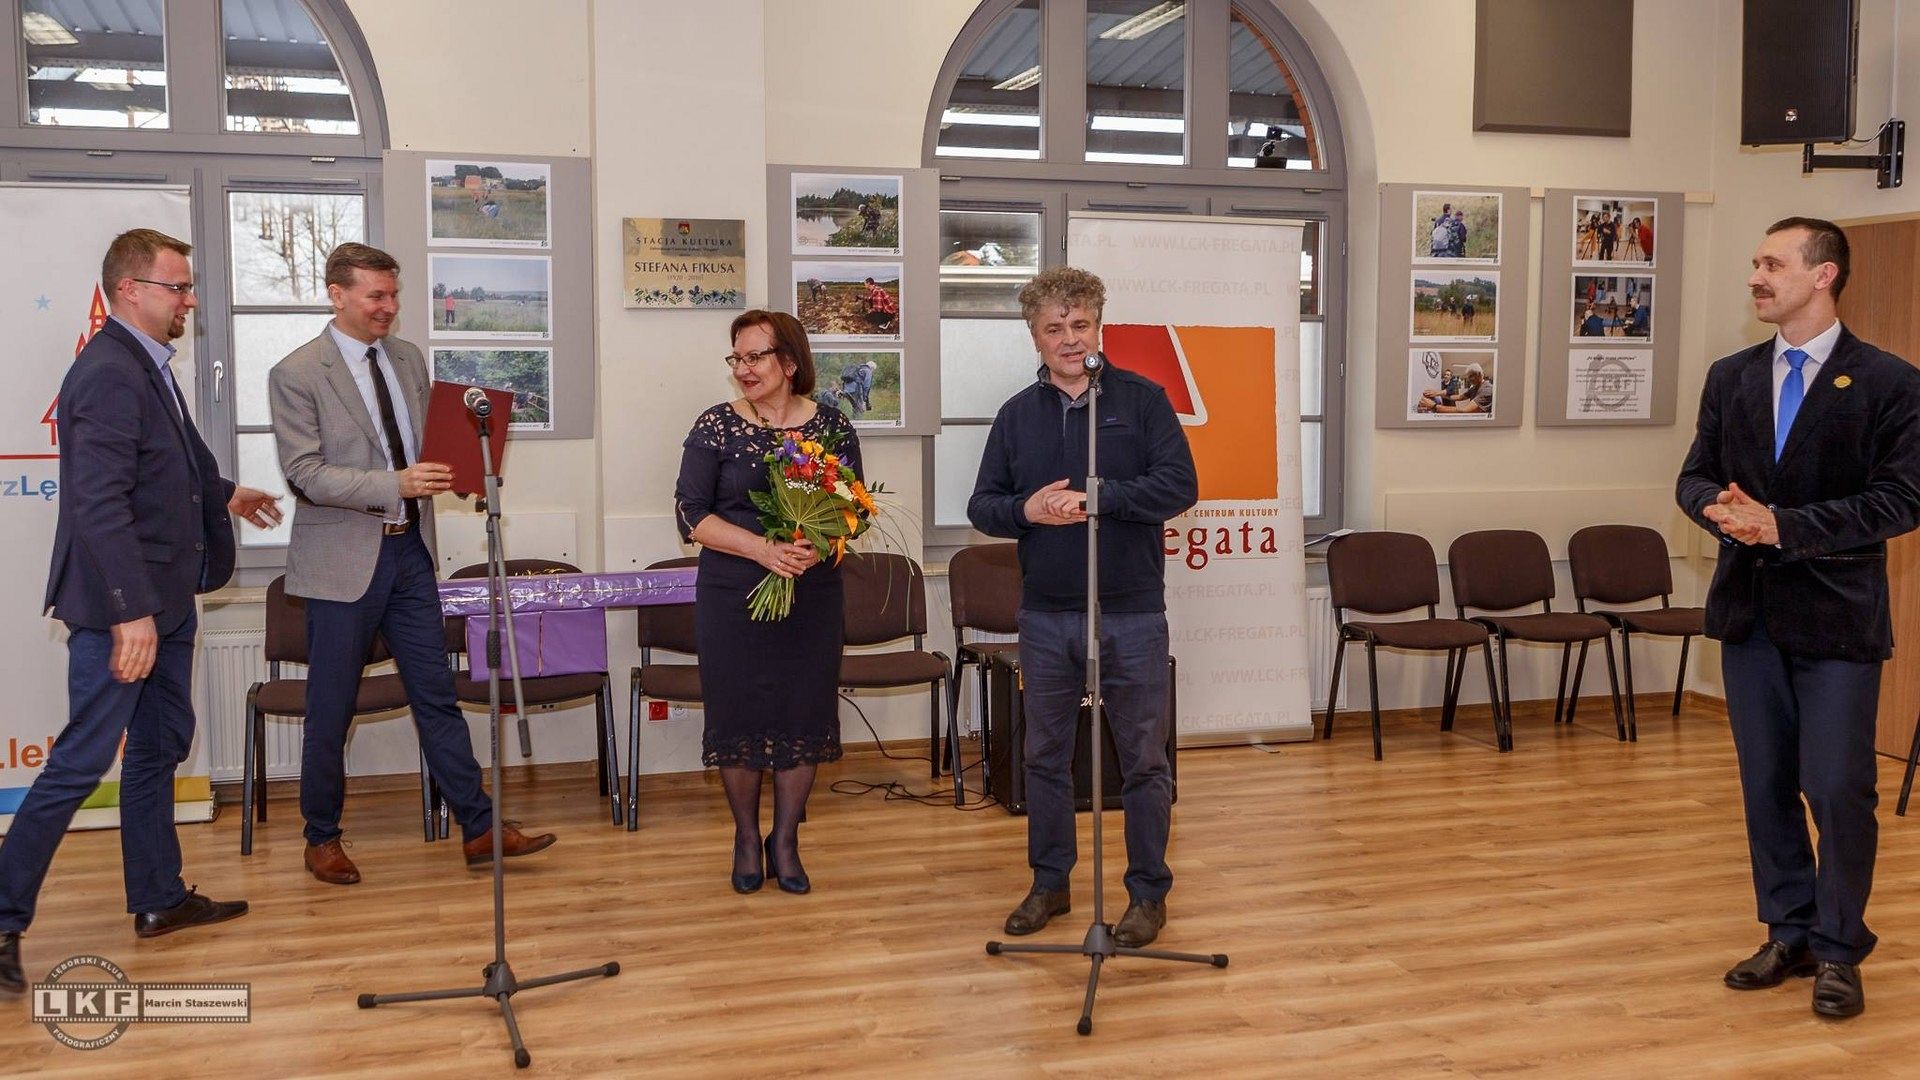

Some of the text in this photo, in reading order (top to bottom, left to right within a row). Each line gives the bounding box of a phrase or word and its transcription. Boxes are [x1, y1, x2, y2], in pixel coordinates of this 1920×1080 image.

[636, 237, 732, 247] STACJA KULTURA
[1069, 233, 1120, 249] TA.PL
[634, 261, 736, 274] STEFANA FIKUSA
[1194, 508, 1235, 518] CENTRUM
[1240, 507, 1280, 517] KULTURY
